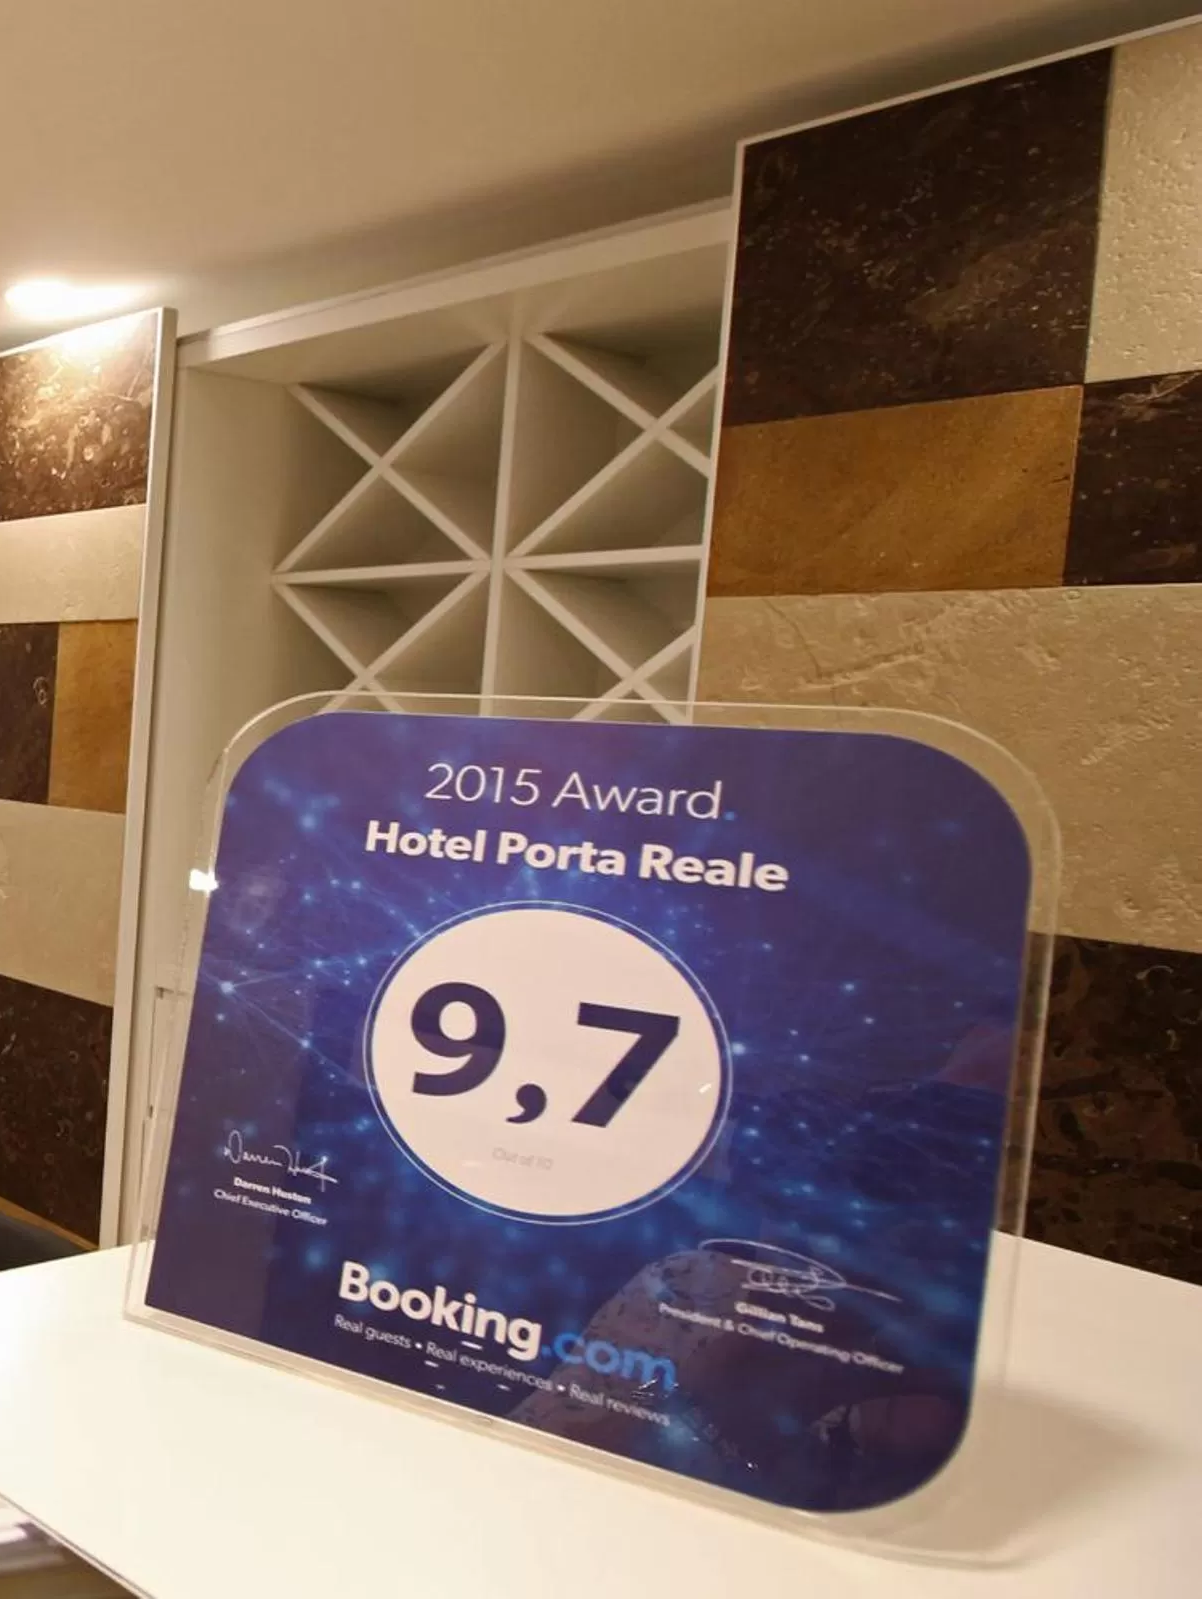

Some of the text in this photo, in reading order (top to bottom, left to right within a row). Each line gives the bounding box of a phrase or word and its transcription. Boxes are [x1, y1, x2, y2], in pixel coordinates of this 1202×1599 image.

[425, 762, 724, 820] 2015 Award
[365, 820, 790, 892] Hotel Porta Reale
[410, 981, 681, 1129] 9,7
[213, 1188, 328, 1226] Chief Executive Officer
[334, 1313, 671, 1427] Real guests Real experiences Real reviews
[737, 1322, 776, 1344] Chief
[777, 1332, 850, 1364] Operating
[851, 1351, 905, 1375] Officer
